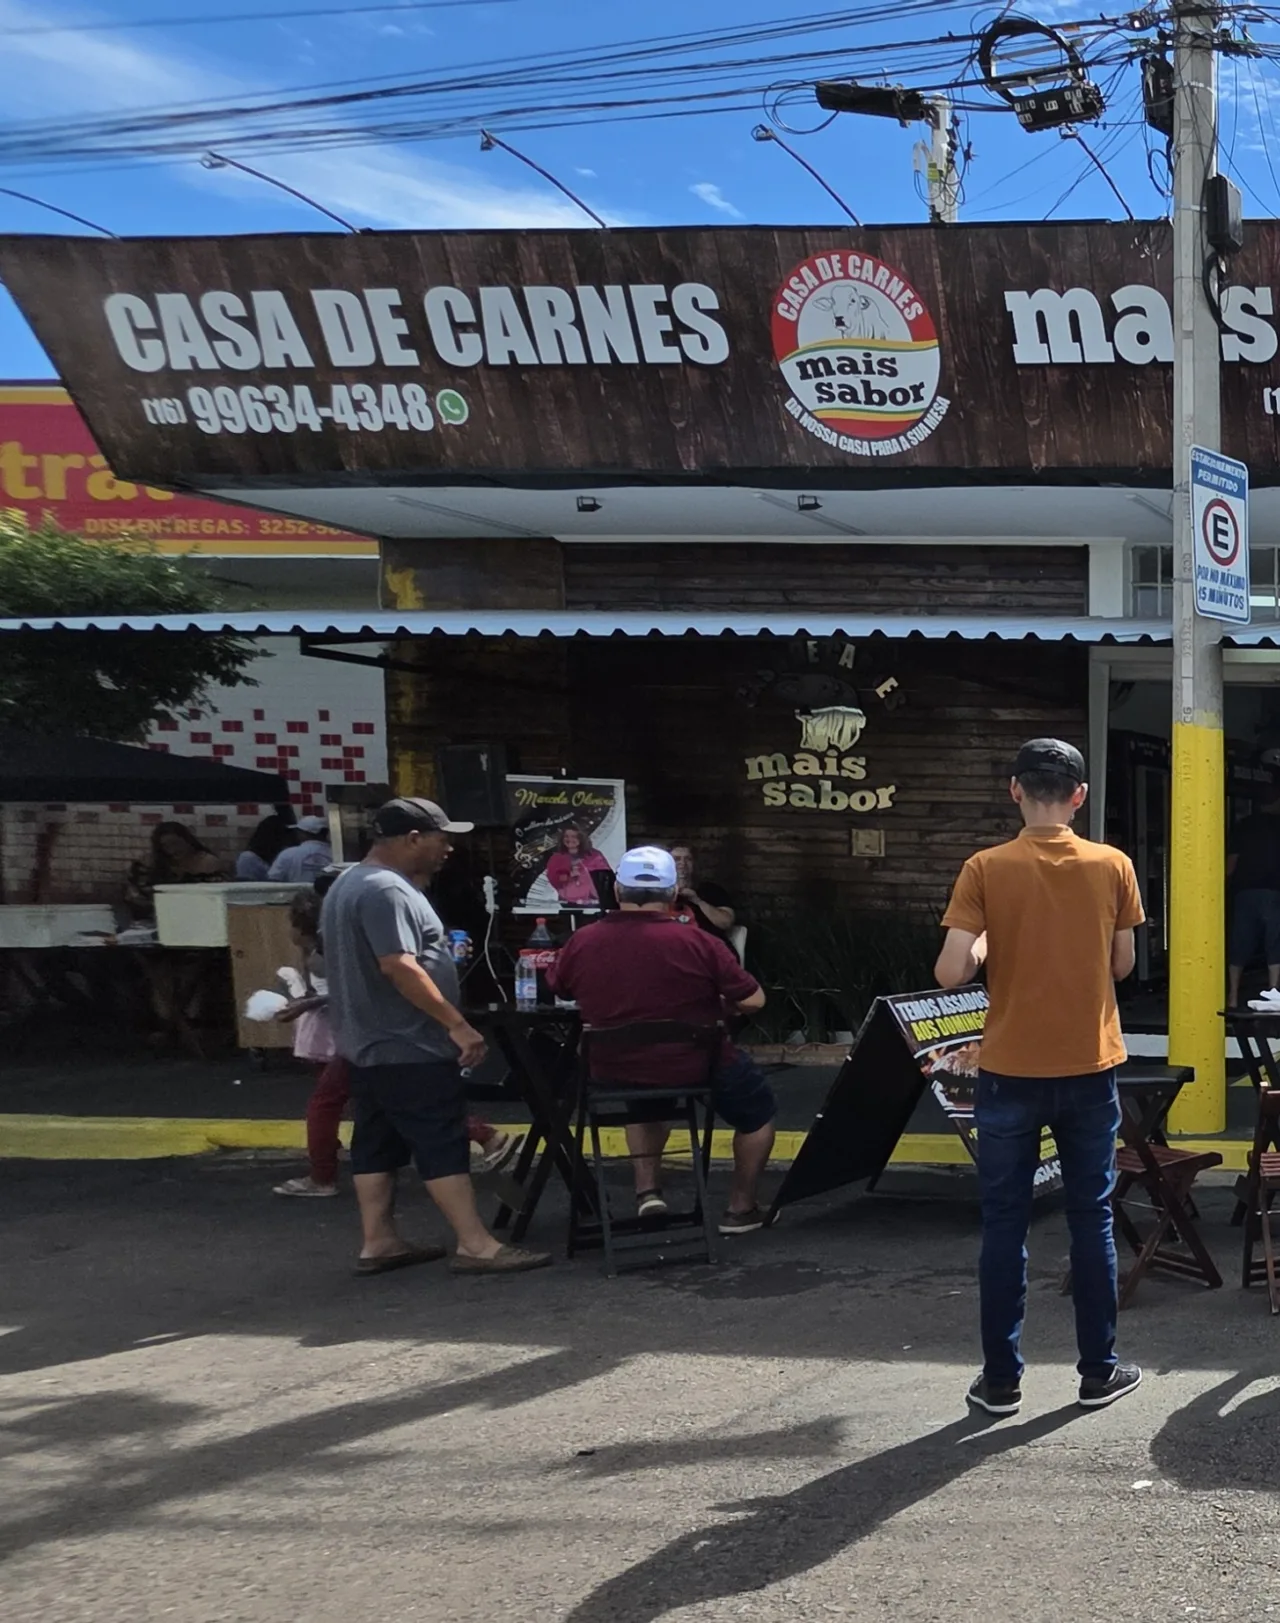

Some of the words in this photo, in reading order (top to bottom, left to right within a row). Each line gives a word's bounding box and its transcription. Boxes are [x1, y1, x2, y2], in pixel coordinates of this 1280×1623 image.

[777, 265, 820, 323] CASA
[815, 253, 845, 280] DE
[847, 254, 924, 323] CARNES
[102, 290, 314, 372] CASA
[310, 287, 420, 369] DE
[423, 282, 731, 366] CARNES
[1003, 281, 1280, 366] mas
[796, 352, 899, 381] mais
[142, 397, 188, 426] (16)
[187, 382, 435, 435] 99634-4348
[784, 397, 801, 421] DA
[814, 379, 926, 407] sabor
[799, 411, 839, 448] NOSSA
[926, 395, 952, 437] MESA
[838, 435, 871, 457] CASA
[870, 438, 903, 457] PARA
[900, 435, 911, 452] A
[905, 426, 933, 447] SUA
[0, 441, 174, 501] tra
[1197, 469, 1239, 493] PERMITIDO
[1212, 513, 1229, 551] E
[744, 750, 867, 781] mais
[762, 780, 897, 812] sabor
[895, 997, 941, 1022] TEMOS
[935, 990, 991, 1016] ASSADOS
[911, 1018, 941, 1042] AOS
[935, 1009, 989, 1037] DOMINGO
